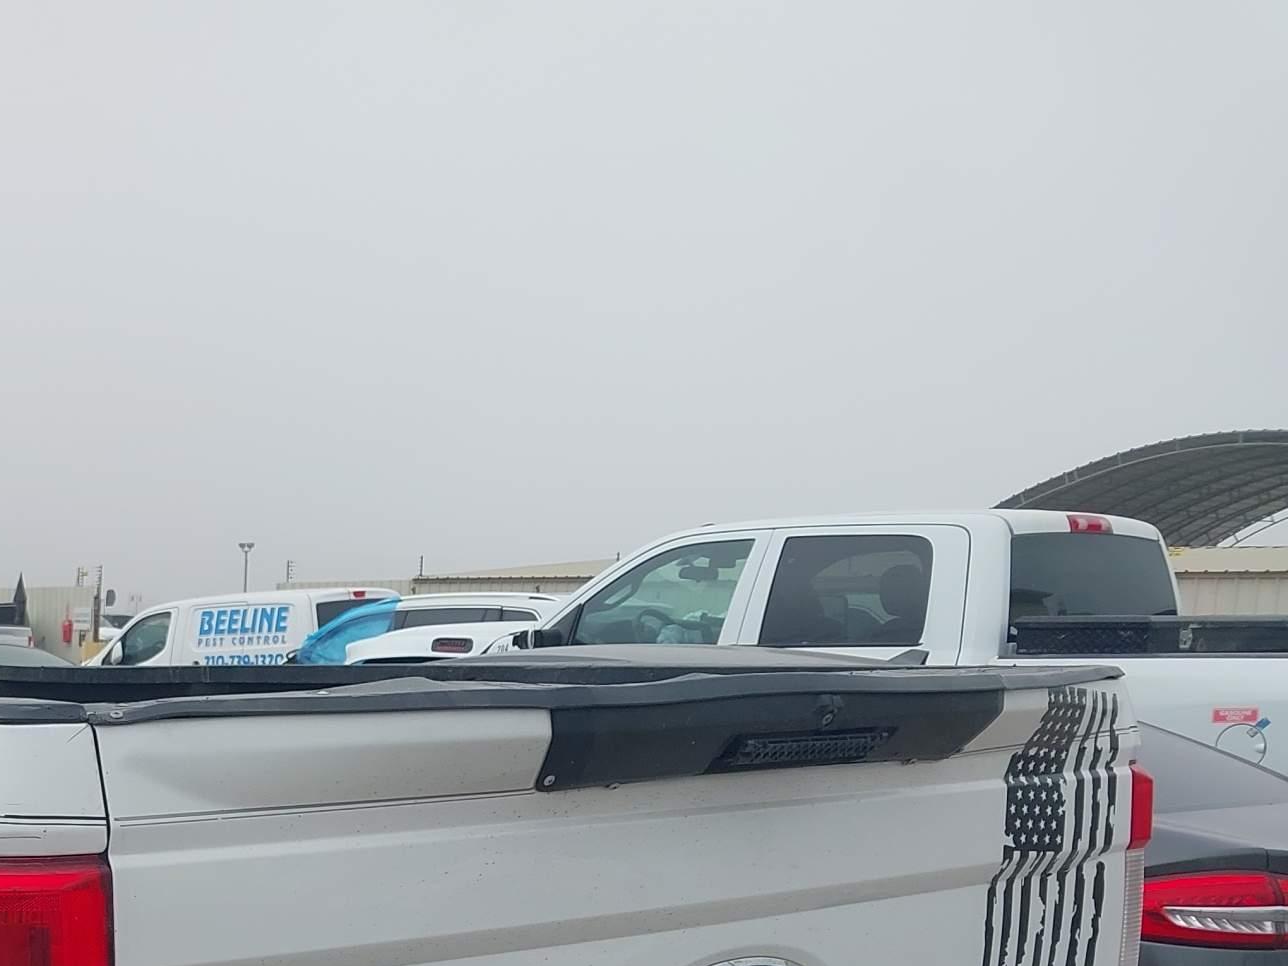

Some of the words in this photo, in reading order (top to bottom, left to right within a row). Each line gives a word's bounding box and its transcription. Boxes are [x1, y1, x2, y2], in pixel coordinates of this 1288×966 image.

[199, 607, 289, 636] BEELINE
[197, 638, 224, 648] PEST
[232, 635, 287, 646] CONTROL
